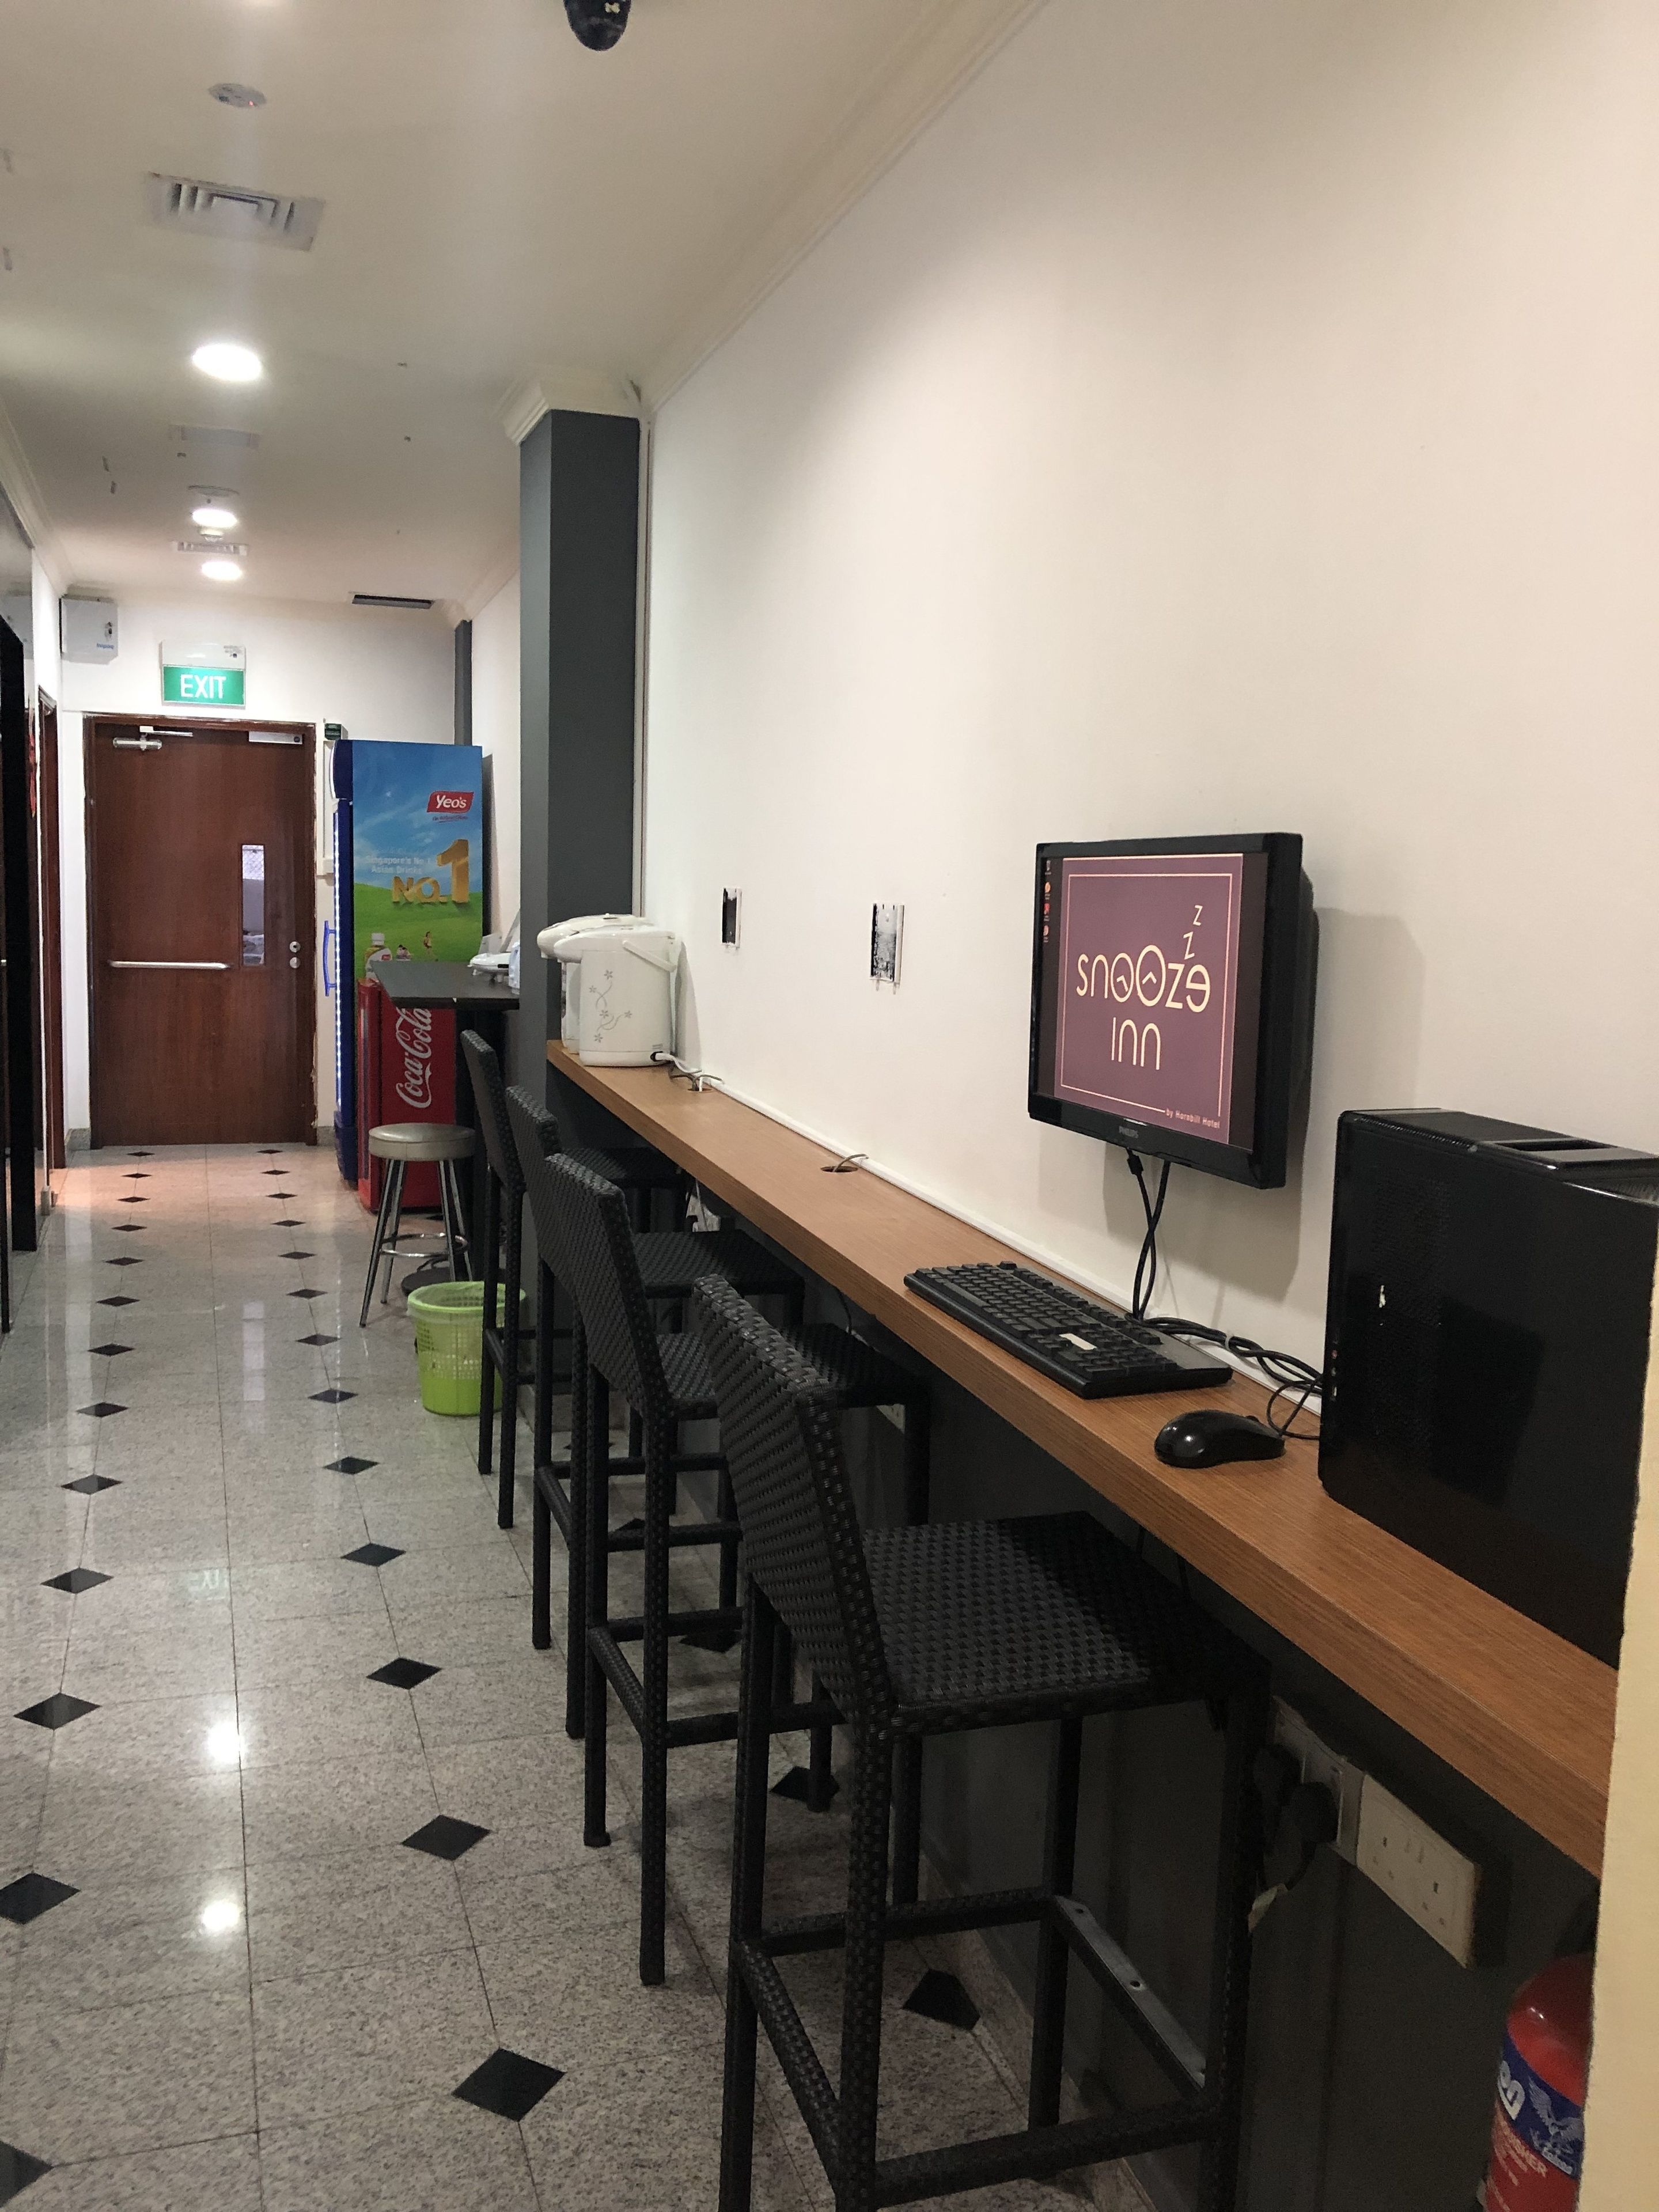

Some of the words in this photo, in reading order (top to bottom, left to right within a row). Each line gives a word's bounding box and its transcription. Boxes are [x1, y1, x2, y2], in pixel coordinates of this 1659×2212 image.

[180, 673, 227, 699] EXIT
[436, 794, 467, 809] Yeo's
[395, 1007, 433, 1108] Coca-Cola
[1166, 1108, 1173, 1119] by
